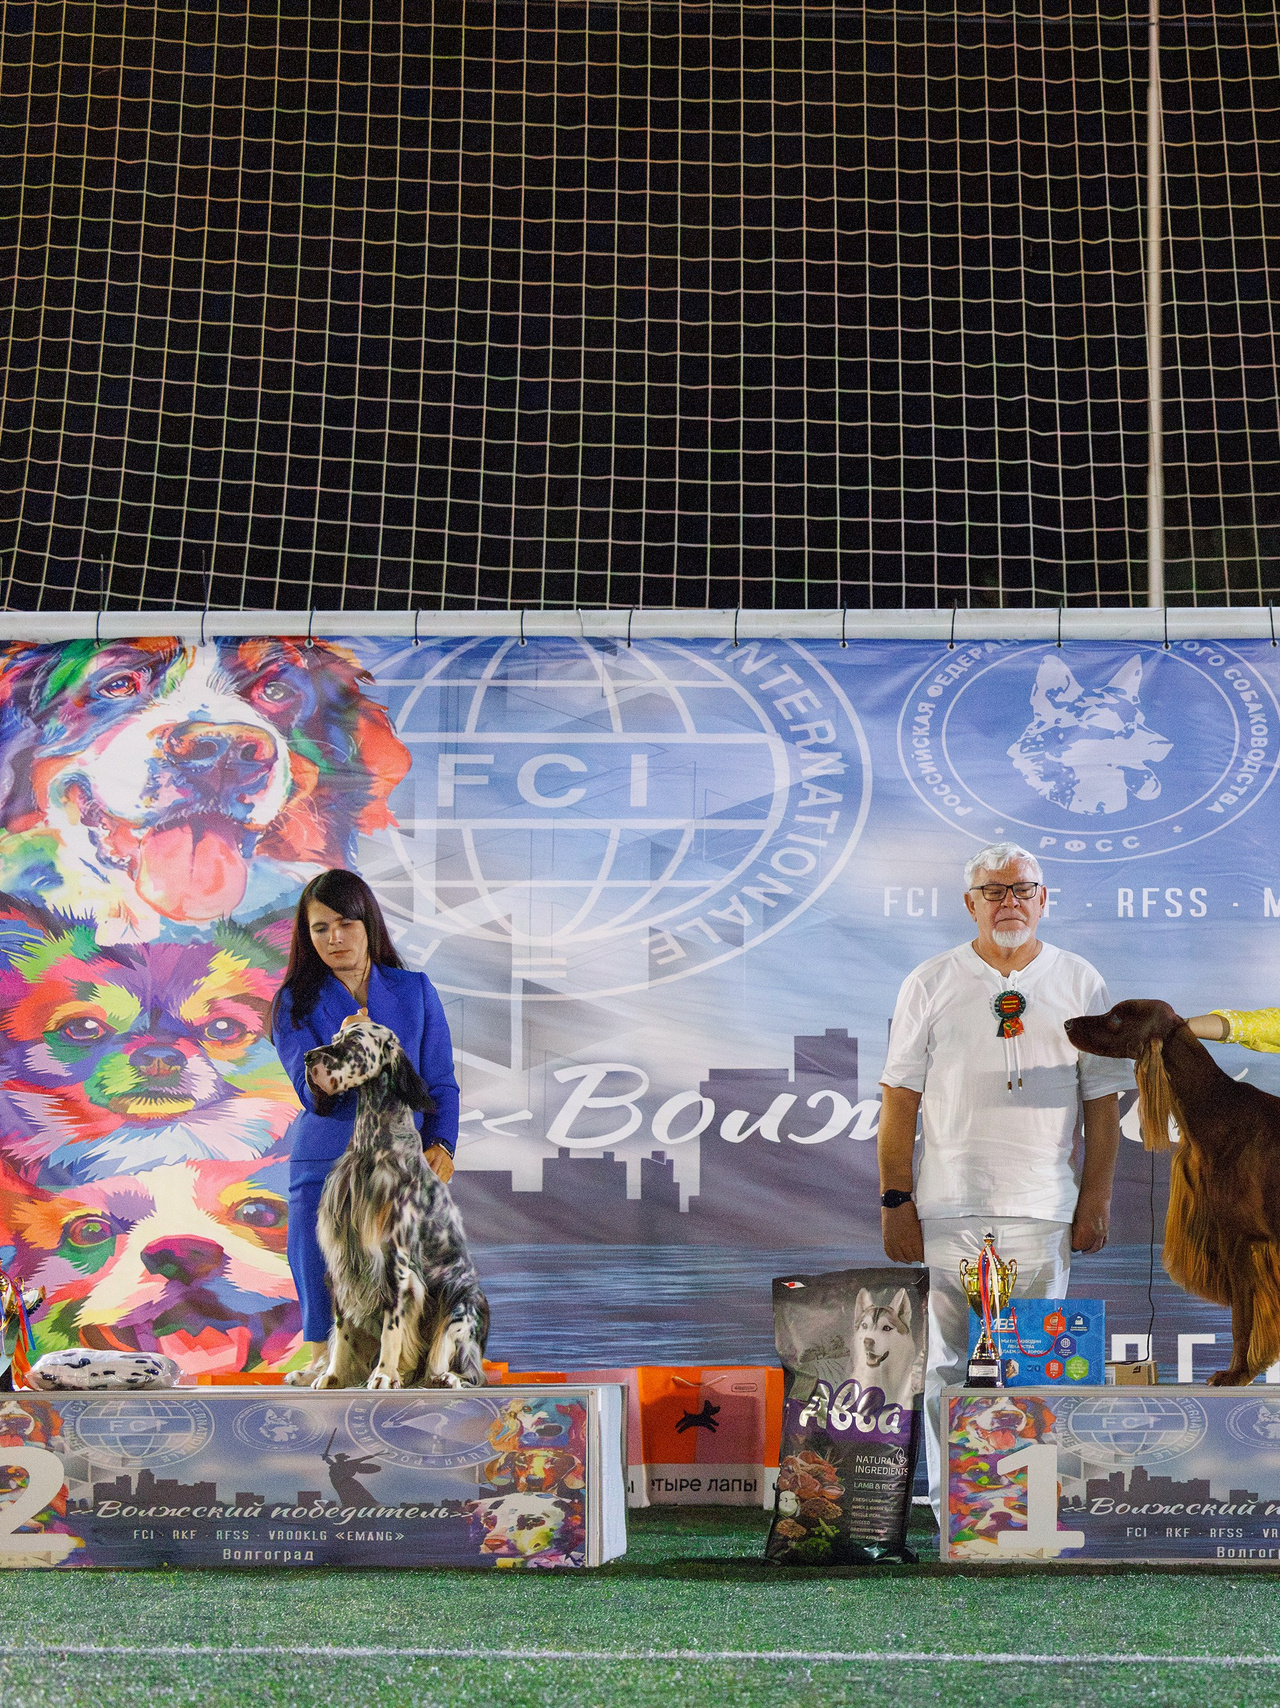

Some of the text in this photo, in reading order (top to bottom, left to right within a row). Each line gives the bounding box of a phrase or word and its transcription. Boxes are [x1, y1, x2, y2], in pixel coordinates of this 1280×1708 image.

[1206, 668, 1268, 813] СОБАКОВОДСТВА
[911, 702, 973, 816] РОССИЙСКАЯ
[437, 753, 648, 808] FCI
[1040, 835, 1140, 852] РФСС
[884, 887, 938, 917] FCI
[1117, 887, 1207, 917] RFSS
[856, 1455, 896, 1466] NATURAL
[855, 1465, 909, 1476] INGREDIENTS
[706, 1478, 757, 1492] лапы
[0, 1446, 76, 1552] 2
[997, 1444, 1085, 1549] 1
[70, 1499, 474, 1526] «Волжский победитель»
[1062, 1497, 1259, 1516] «Волжский
[133, 1529, 154, 1540] FCI
[173, 1529, 198, 1540] RKF
[216, 1529, 249, 1540] RFSS
[335, 1530, 404, 1541] «EMANG»
[1126, 1527, 1147, 1538] FCI
[1166, 1527, 1190, 1538] RKF
[1210, 1527, 1243, 1538] RFSS
[223, 1548, 314, 1562] Волгоград
